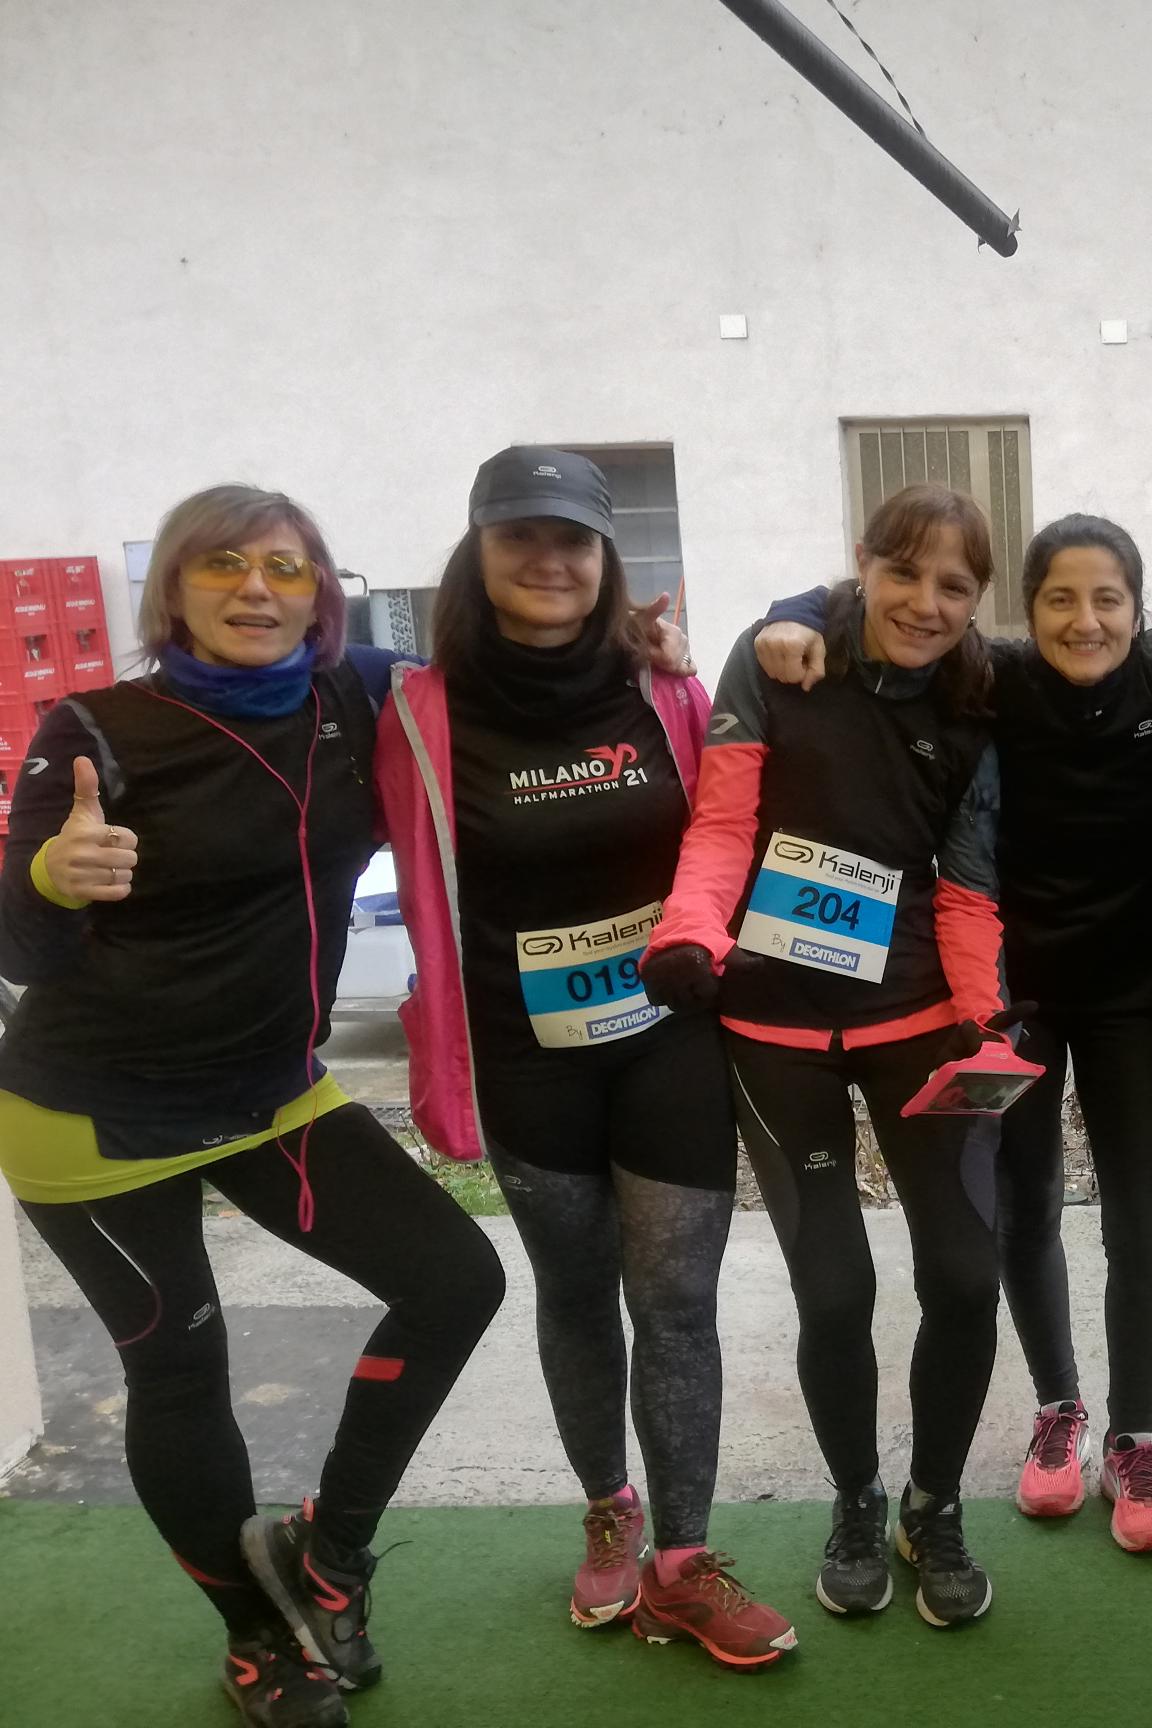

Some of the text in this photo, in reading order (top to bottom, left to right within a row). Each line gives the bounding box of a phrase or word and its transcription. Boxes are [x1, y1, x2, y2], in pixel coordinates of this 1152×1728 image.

[509, 759, 649, 790] MILANO 21
[513, 780, 620, 805] HALFMARATHON
[818, 851, 896, 895] Kalenji
[791, 886, 861, 931] 204
[794, 942, 857, 968] DECATHLON
[567, 957, 641, 1003] 019
[591, 1006, 658, 1036] DECATHLON
